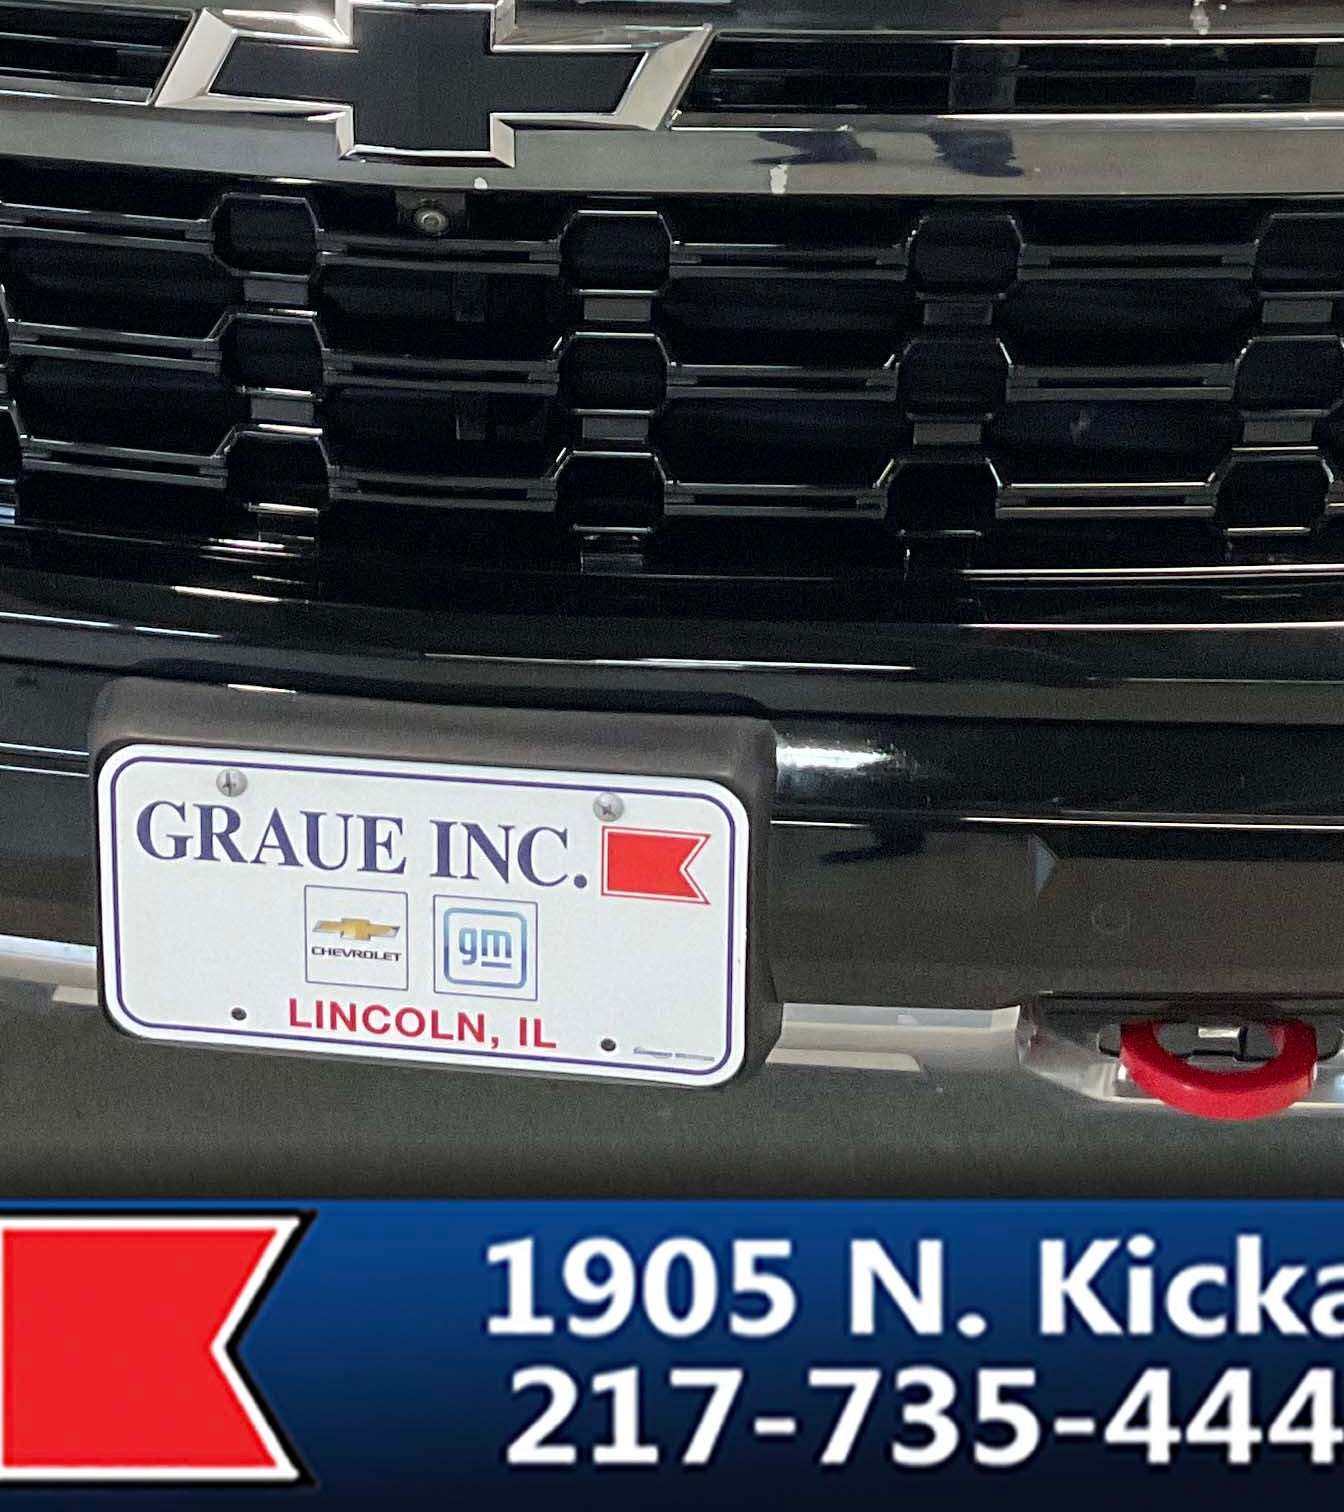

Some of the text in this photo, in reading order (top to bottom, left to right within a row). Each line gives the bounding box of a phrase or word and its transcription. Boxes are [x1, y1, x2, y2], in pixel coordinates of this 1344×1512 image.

[136, 800, 588, 889] GRAUE INC.
[310, 945, 403, 963] CHEVROLET
[459, 927, 513, 969] gm
[289, 998, 557, 1050] LINCOLN, IL
